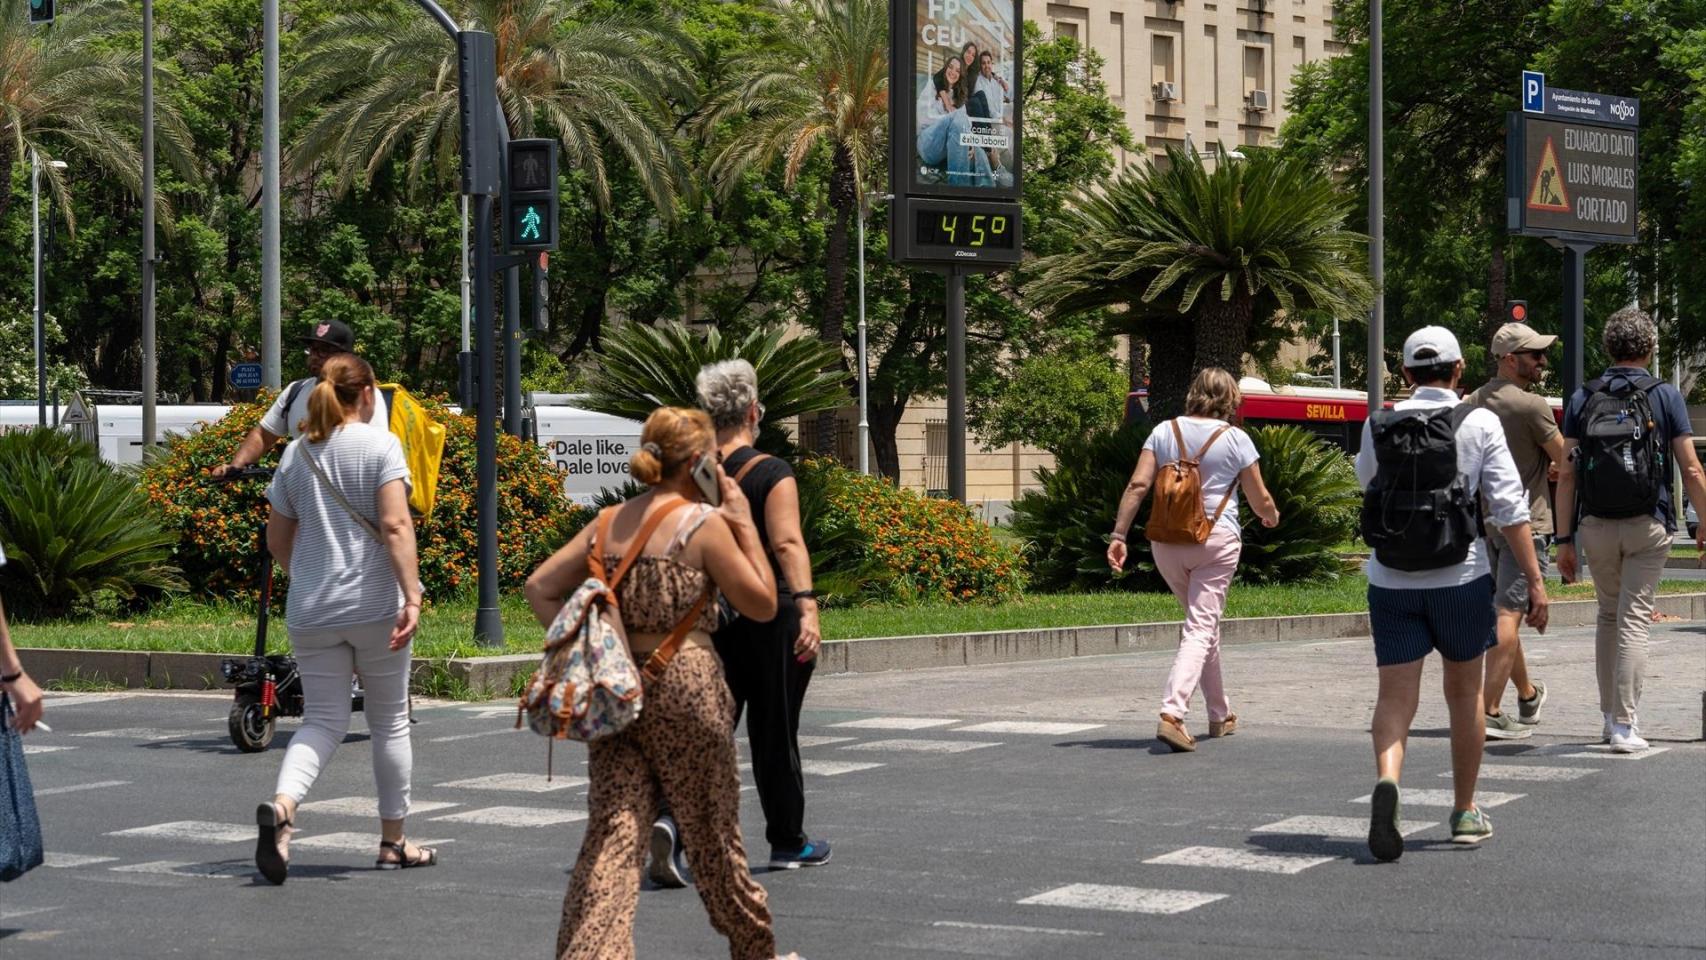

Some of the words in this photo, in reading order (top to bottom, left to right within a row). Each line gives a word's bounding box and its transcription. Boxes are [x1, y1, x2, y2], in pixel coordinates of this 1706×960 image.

[928, 0, 961, 20] FP
[921, 24, 966, 48] CEU
[1527, 79, 1539, 104] P
[1552, 92, 1581, 103] Ayuntamiento
[1581, 96, 1587, 104] de
[1587, 97, 1600, 106] Sevilla
[961, 135, 980, 144] éxito
[981, 136, 1007, 146] laboral
[1564, 128, 1608, 154] EDUARDO
[1610, 134, 1635, 157] DATO
[1568, 162, 1590, 184] LUIS
[1591, 164, 1635, 189] MORALES
[1577, 196, 1627, 224] CORTADO
[1306, 403, 1345, 419] SEVILLA
[556, 439, 593, 455] Dale
[596, 439, 629, 455] like.
[556, 458, 593, 474] Dale
[597, 458, 630, 474] love
